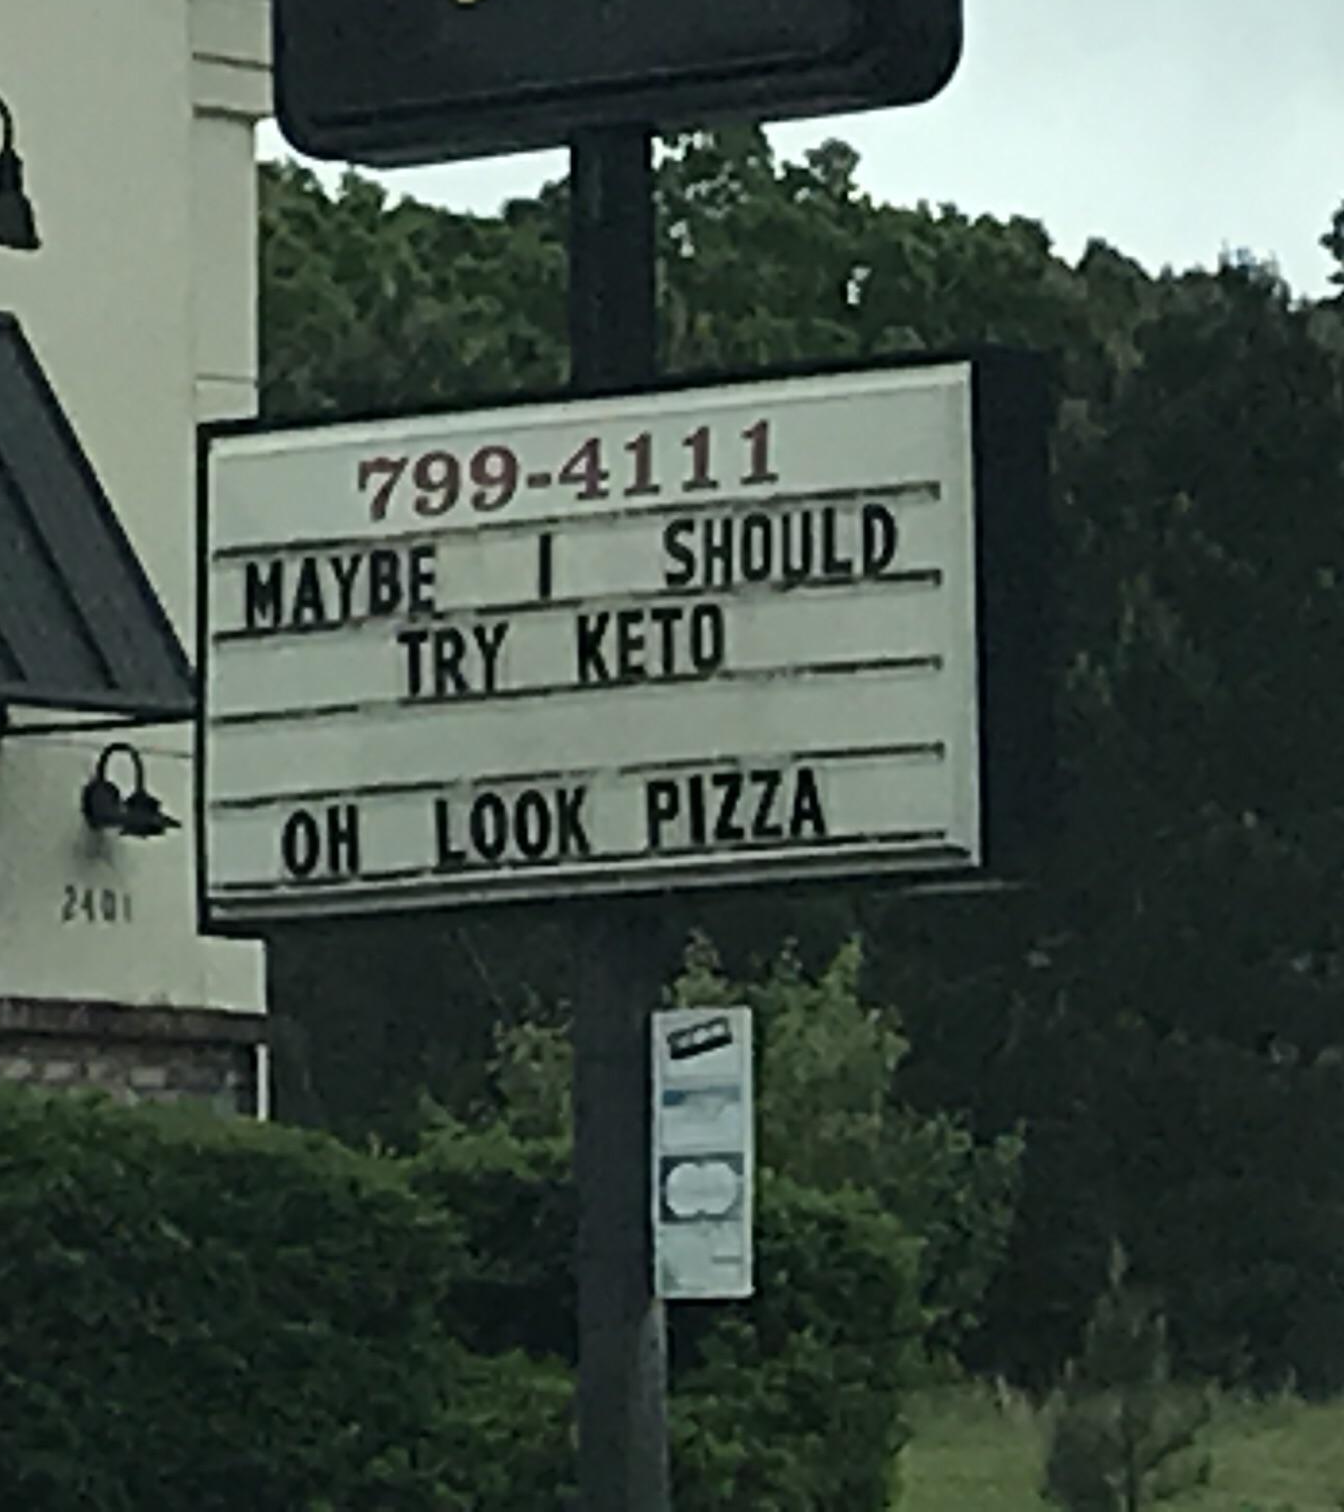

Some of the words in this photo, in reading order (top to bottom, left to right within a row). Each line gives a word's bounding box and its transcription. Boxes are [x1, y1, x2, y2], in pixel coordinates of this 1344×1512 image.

[358, 419, 779, 521] 799-4111
[244, 545, 438, 629] MAYBE
[537, 535, 553, 600] I
[664, 504, 898, 590] SHOULD
[397, 622, 508, 698] TRY
[576, 603, 724, 684] KETO
[282, 804, 359, 878] OH
[435, 785, 591, 864] LOOK
[646, 768, 827, 850] PIZZA
[62, 885, 132, 924] 2401
